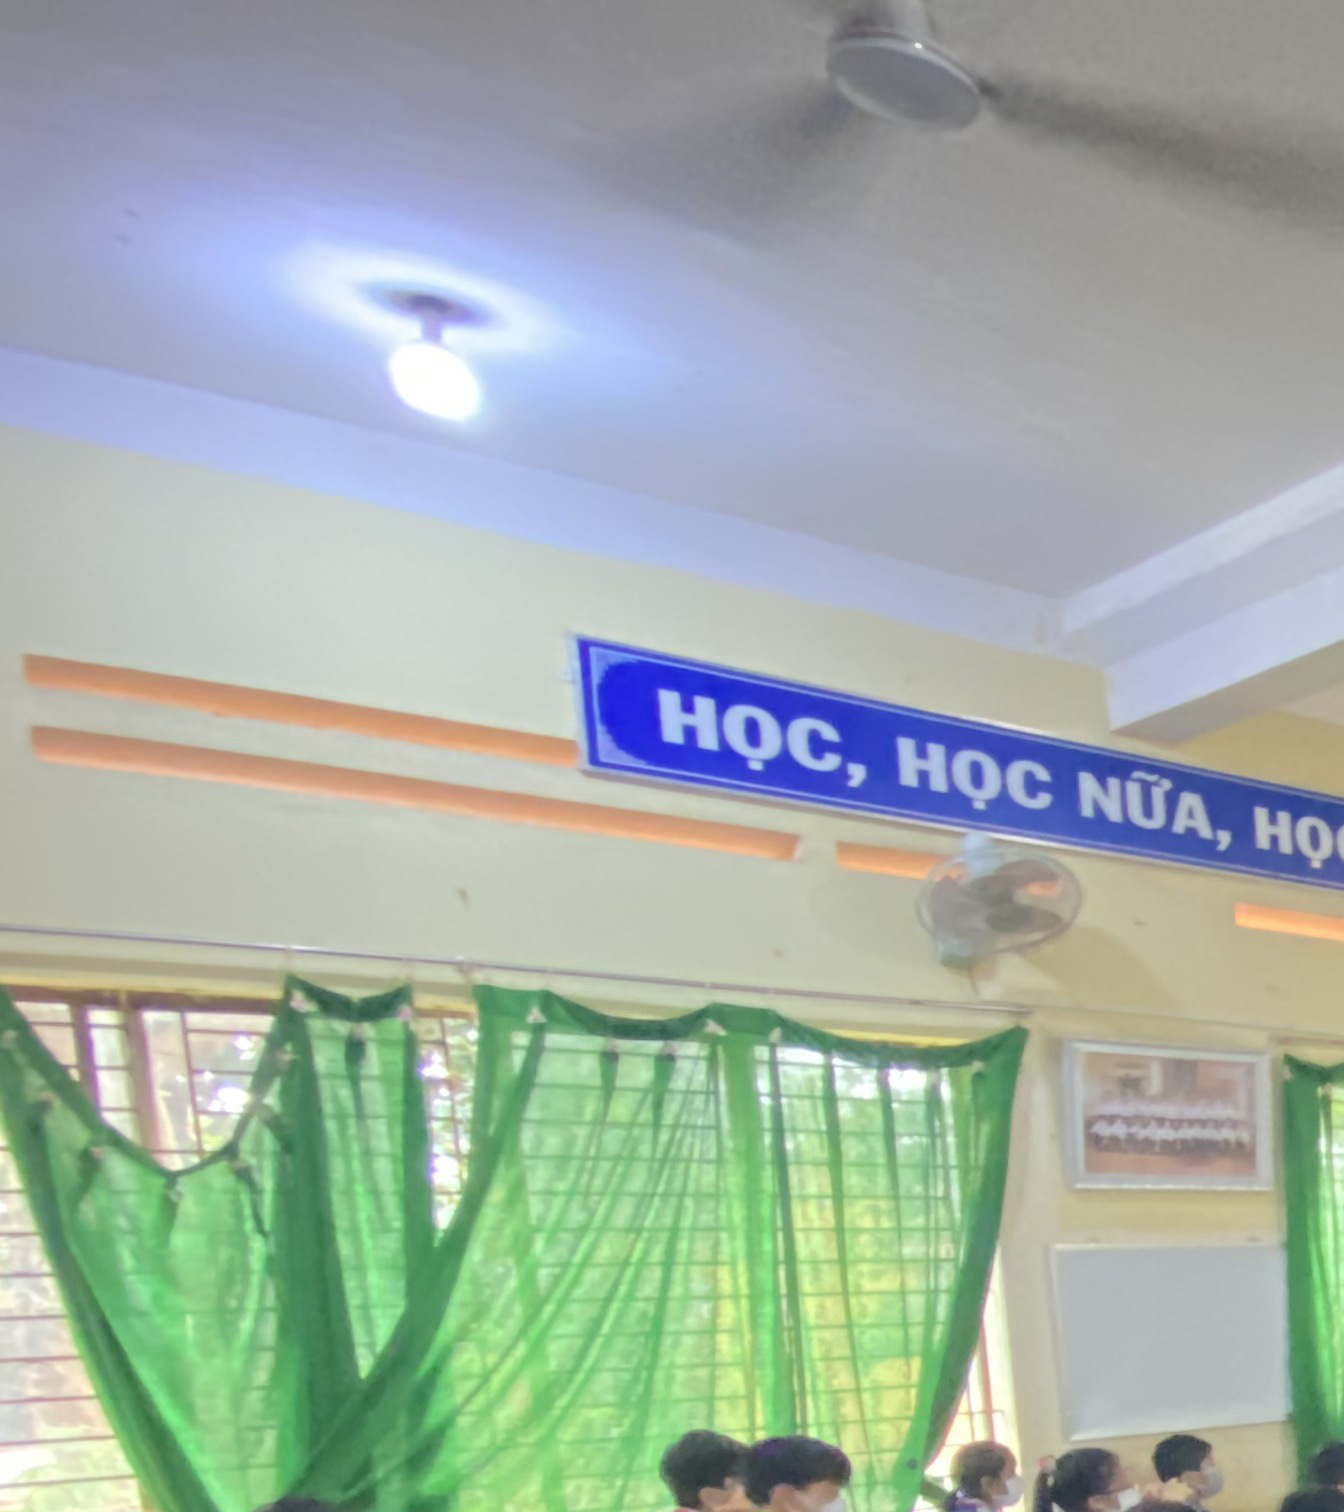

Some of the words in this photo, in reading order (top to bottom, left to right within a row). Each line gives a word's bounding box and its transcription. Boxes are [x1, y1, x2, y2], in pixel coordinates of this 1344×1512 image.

[657, 688, 868, 789] HỌC,
[895, 736, 1053, 812] HỌC
[1077, 770, 1233, 852] NỮA,
